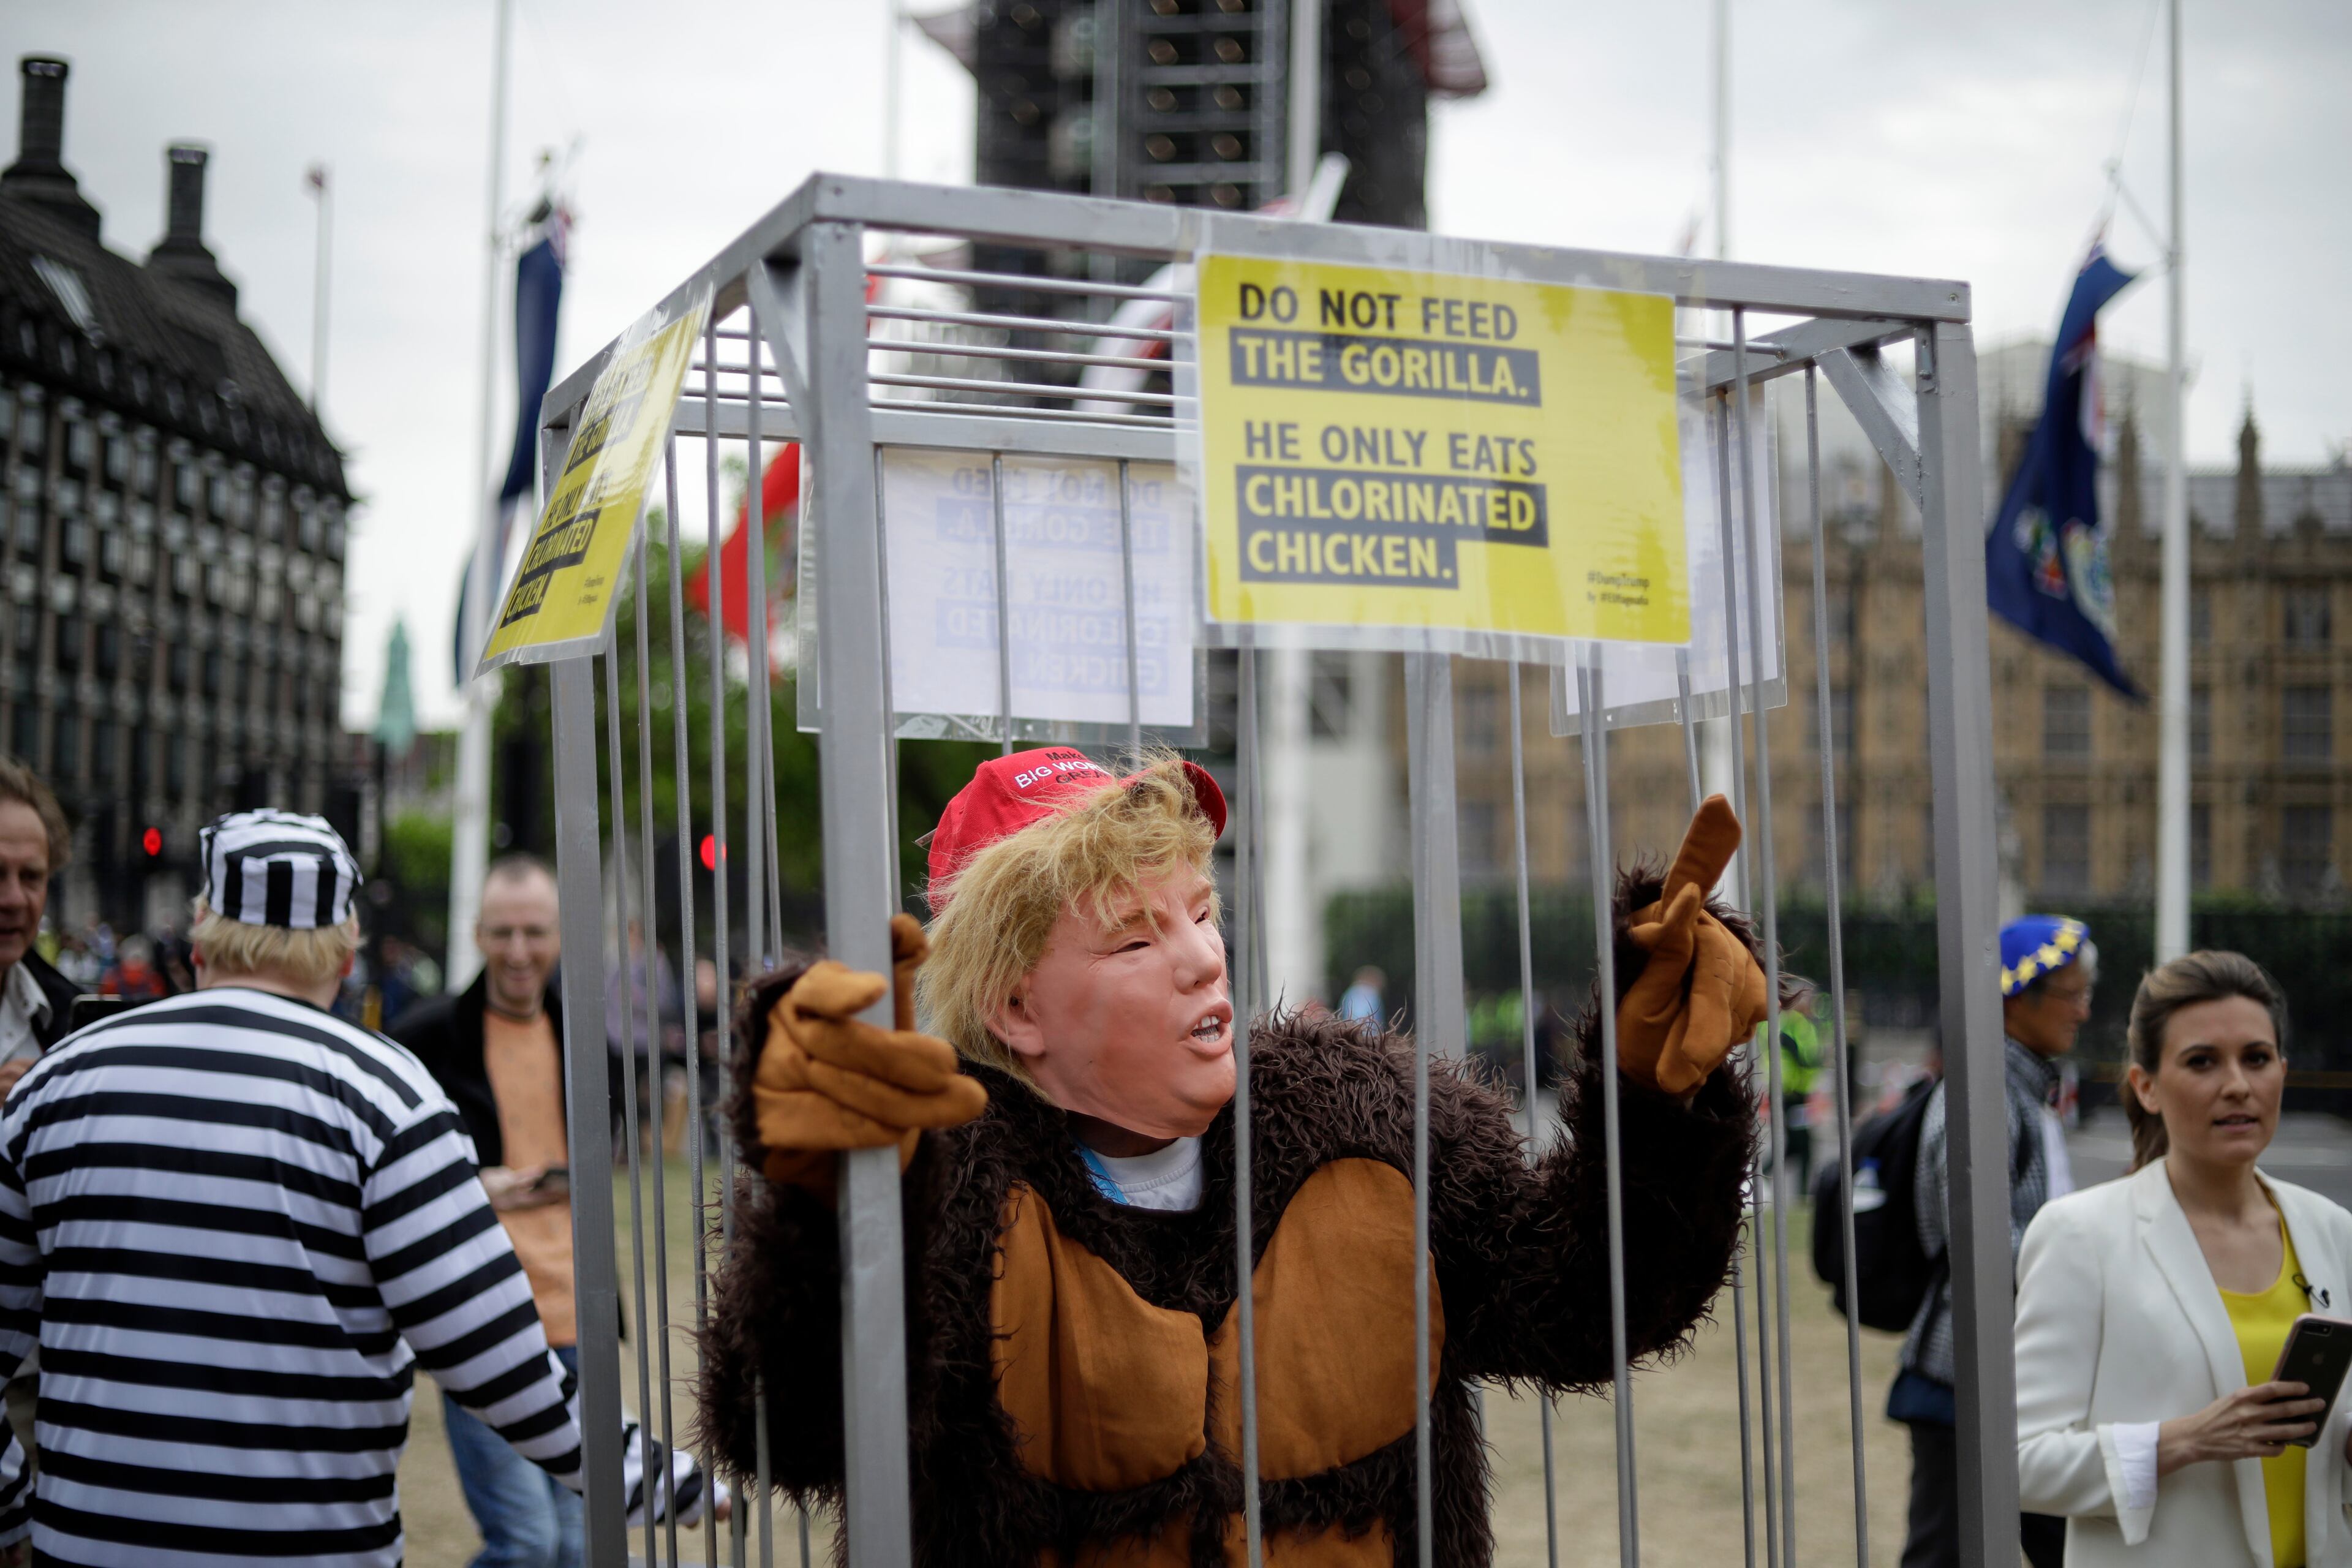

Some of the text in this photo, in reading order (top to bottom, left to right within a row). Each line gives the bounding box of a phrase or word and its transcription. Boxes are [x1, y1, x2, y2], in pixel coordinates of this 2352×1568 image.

[1239, 283, 1518, 341] DO NOT FEED
[1237, 337, 1529, 398] THE GORILLA.
[1245, 421, 1537, 477] HE ONLY EATS
[1245, 474, 1536, 532] CHLORINATED
[524, 516, 595, 575] CHLORINATED
[1247, 530, 1453, 579] CHICKEN.
[505, 573, 548, 619] CHICKEN.
[1014, 766, 1053, 789] BIG
[1055, 770, 1109, 785] GREA
